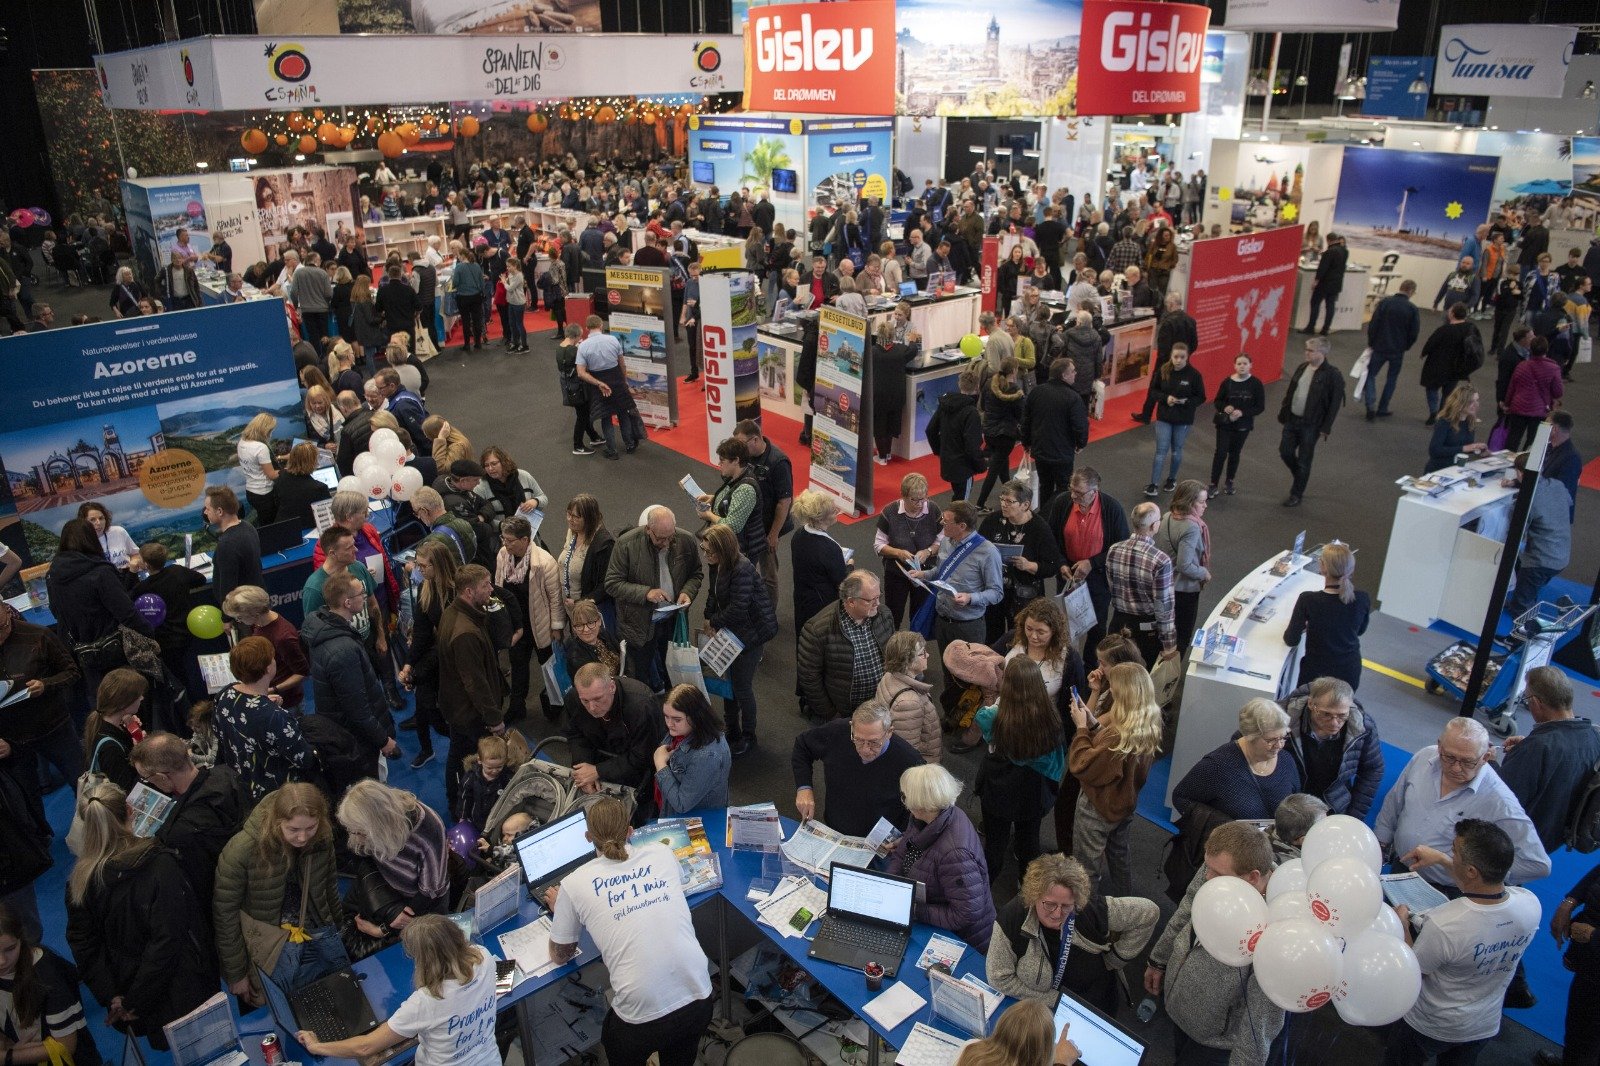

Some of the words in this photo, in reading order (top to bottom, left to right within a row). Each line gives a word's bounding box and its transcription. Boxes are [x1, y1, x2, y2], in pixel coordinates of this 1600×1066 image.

[755, 12, 874, 73] Gislev
[1100, 11, 1202, 73] Gislev
[482, 41, 542, 74] SPANIEN
[1445, 38, 1535, 79] Tunisia
[264, 84, 320, 103] ESPAÑA
[494, 77, 518, 95] DEL
[523, 73, 541, 91] DIG
[773, 89, 786, 101] DEL
[788, 88, 836, 102] DRØMMEN
[1132, 90, 1146, 103] DEL
[1147, 91, 1187, 104] DRØMMEN
[1237, 239, 1265, 256] Gislev
[610, 271, 660, 282] MESSETILBUD
[981, 265, 992, 294] Gislev
[823, 310, 864, 331] MESSETILBUD
[81, 340, 141, 357] Naturoplevelser
[146, 332, 198, 346] verdensklasse
[93, 350, 197, 380] Azorerne
[703, 325, 728, 424] Gislev
[33, 400, 46, 408] Du
[82, 389, 100, 398] ikke
[102, 388, 111, 396] at
[112, 384, 132, 397] rejse
[134, 381, 142, 390] til
[143, 377, 174, 389] verdens
[176, 373, 195, 383] ende
[196, 370, 208, 378] for
[209, 369, 217, 377] at
[229, 362, 258, 375] paradis.
[77, 401, 89, 410] Du
[90, 398, 106, 408] kan
[131, 389, 149, 399] med
[150, 388, 159, 396] at
[160, 385, 180, 397] rejse
[181, 381, 189, 390] til
[190, 376, 224, 389] Azorerne
[149, 460, 192, 475] Azorerne
[592, 864, 652, 897] Præmier
[608, 889, 627, 908] for
[631, 883, 641, 898] 1
[1473, 933, 1532, 962] Præmier
[456, 1029, 475, 1049] for
